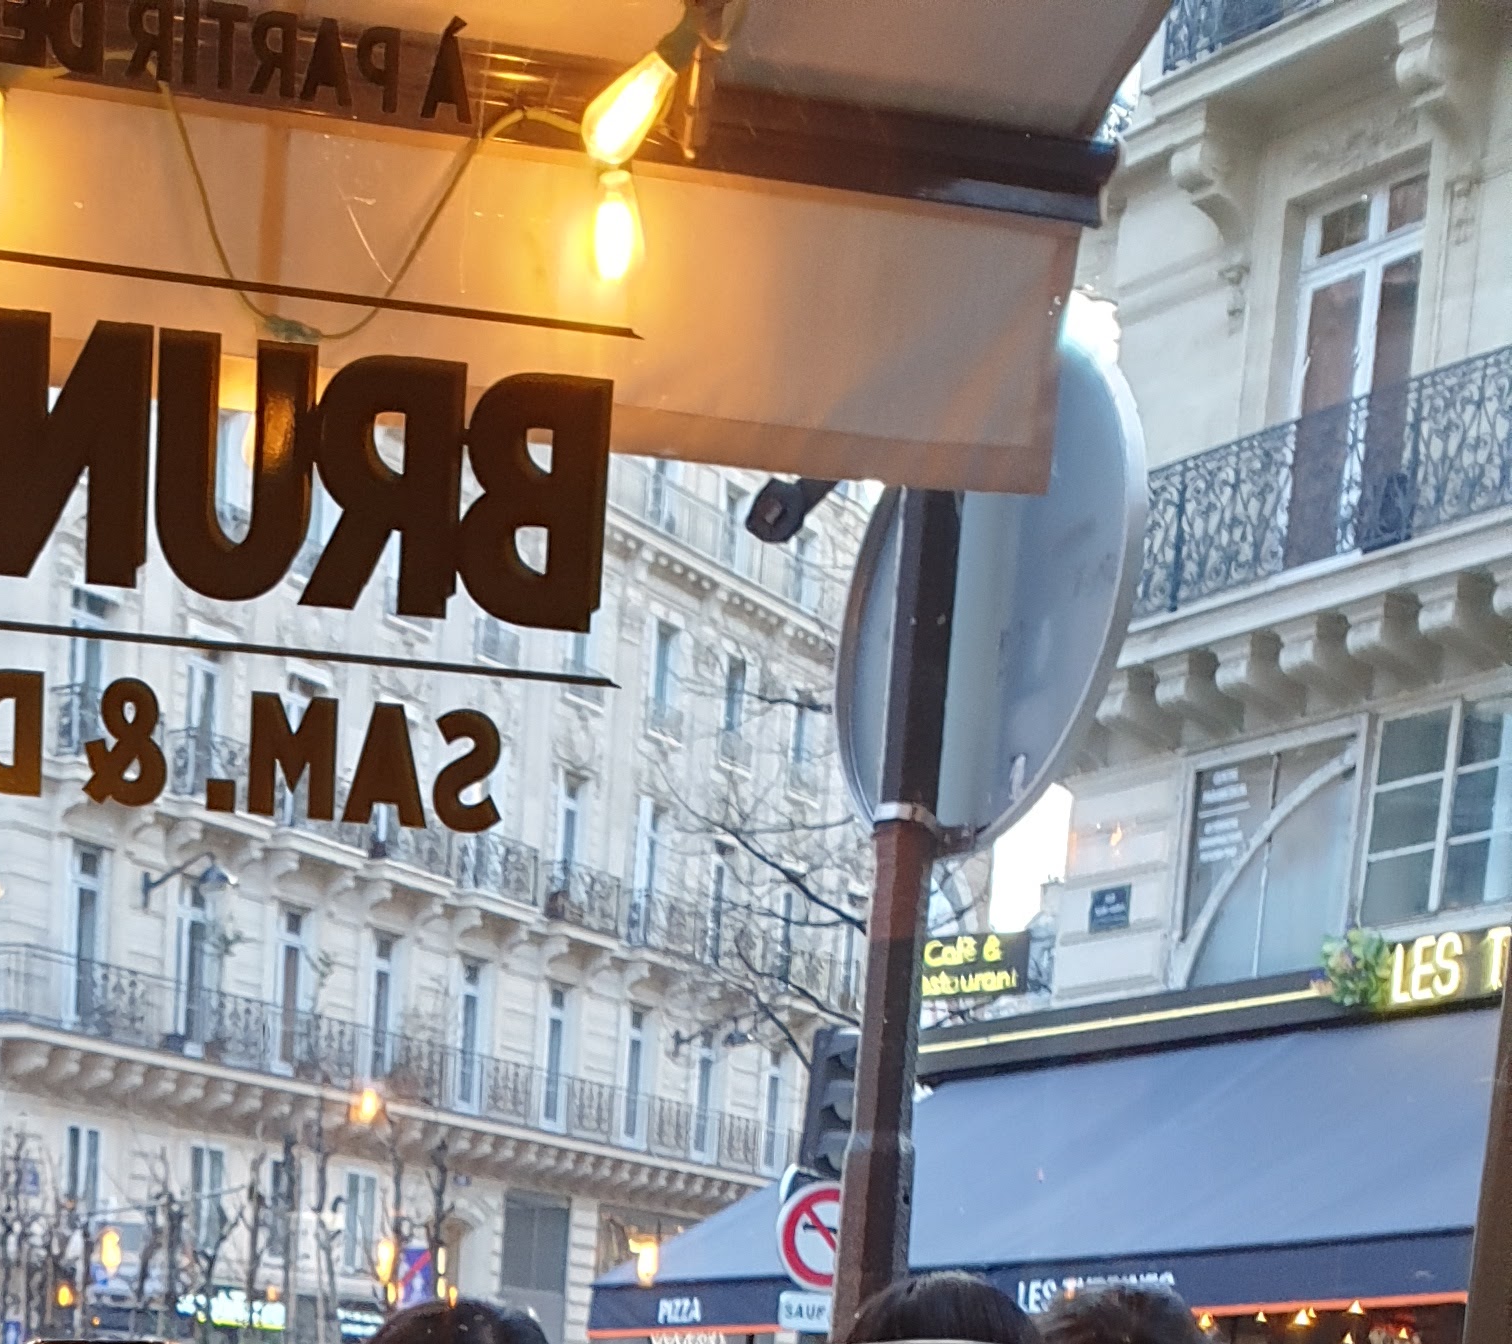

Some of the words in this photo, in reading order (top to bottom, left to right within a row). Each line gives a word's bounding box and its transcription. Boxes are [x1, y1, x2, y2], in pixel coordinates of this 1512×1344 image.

[923, 935, 978, 968] Café
[982, 934, 1003, 963] &
[1391, 931, 1464, 1004] LES
[657, 1296, 702, 1325] PIZZA
[783, 1302, 827, 1321] SAUF
